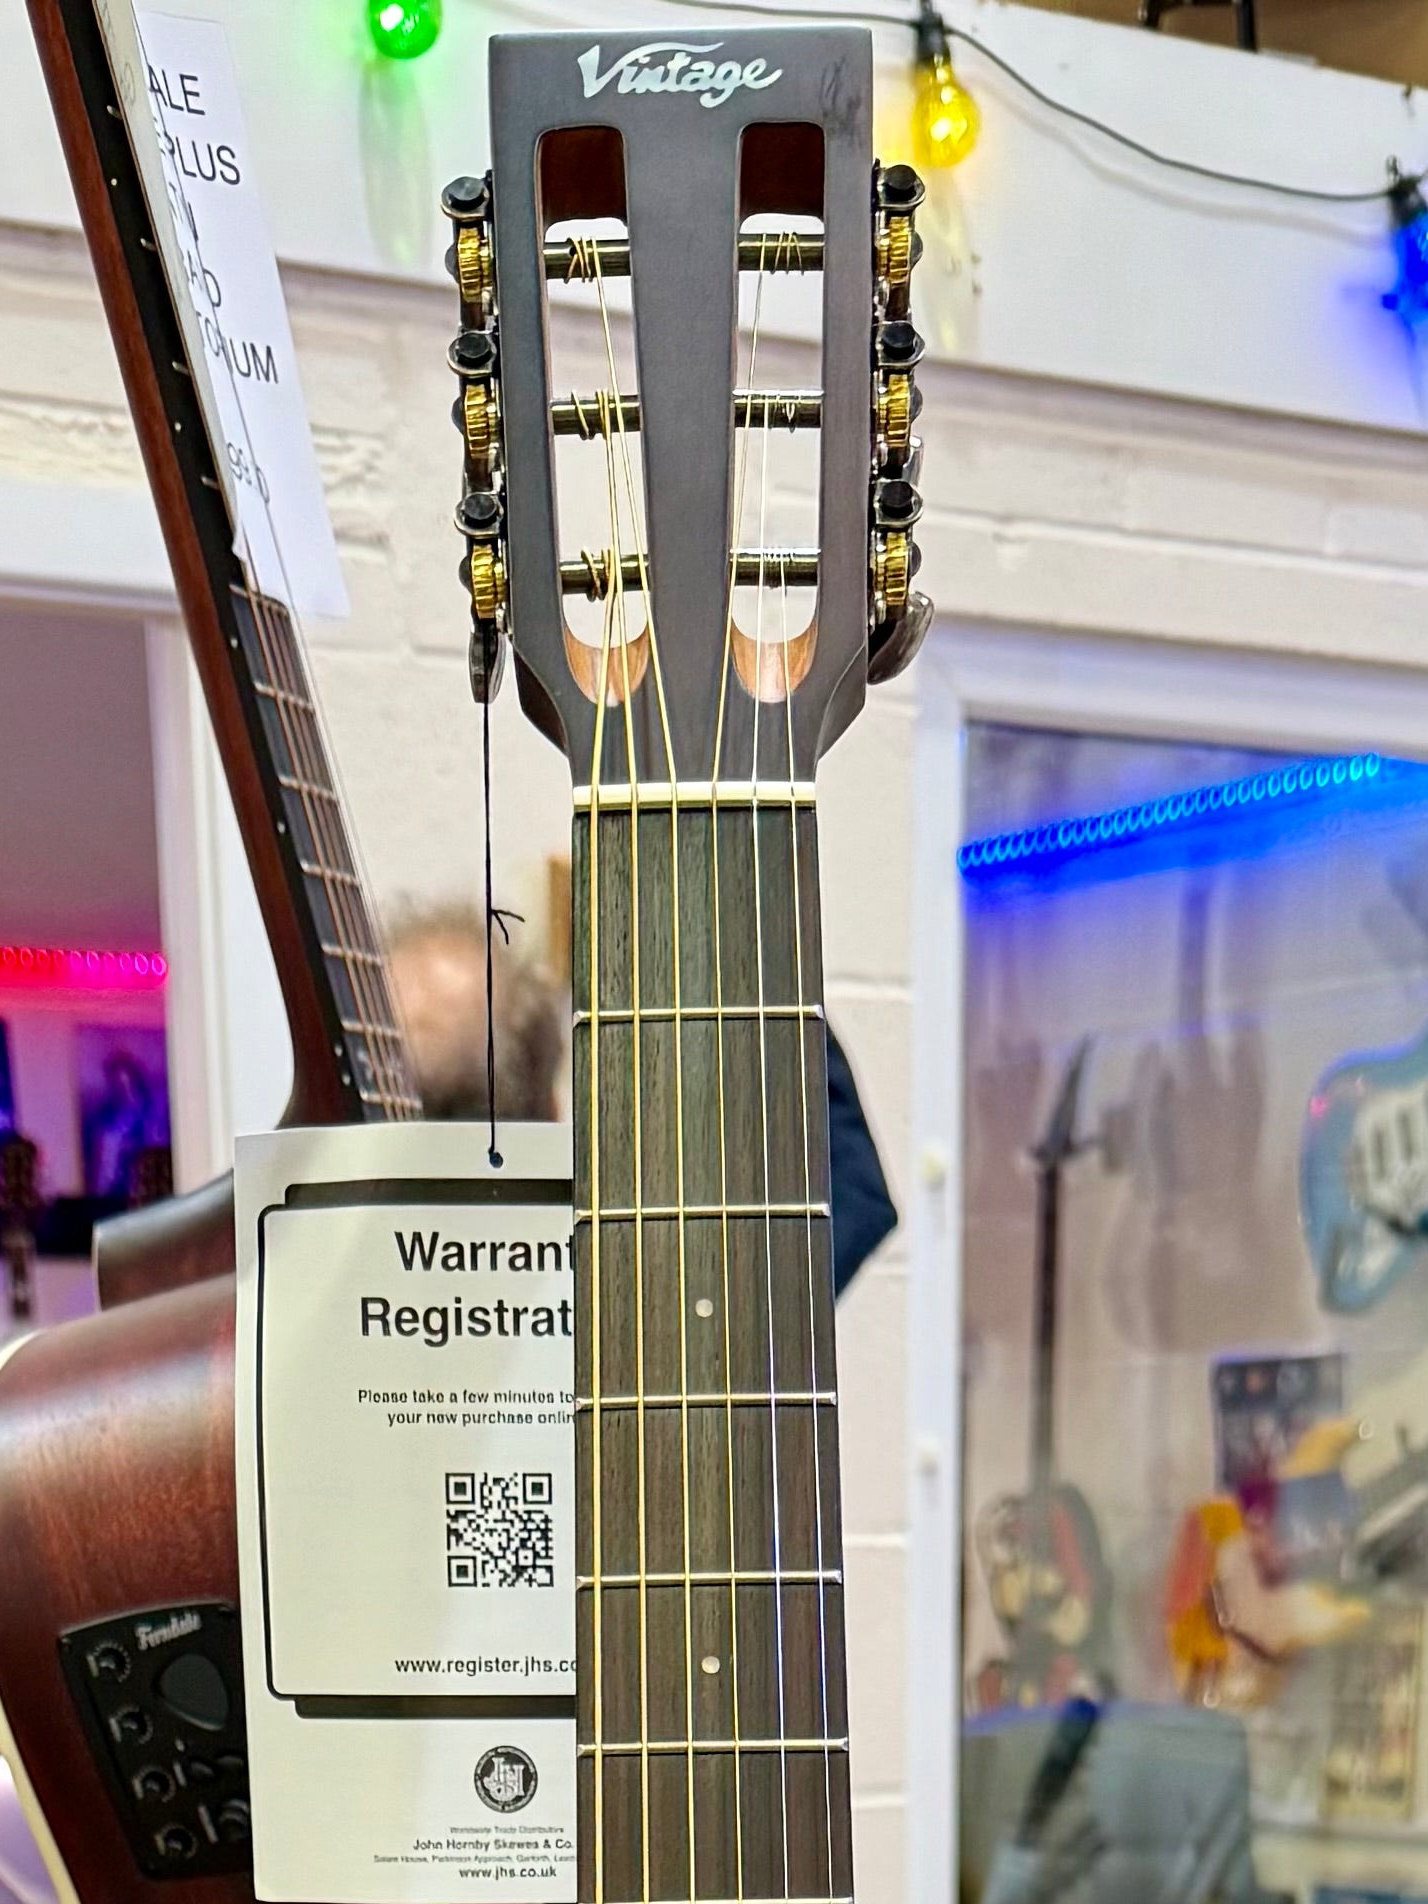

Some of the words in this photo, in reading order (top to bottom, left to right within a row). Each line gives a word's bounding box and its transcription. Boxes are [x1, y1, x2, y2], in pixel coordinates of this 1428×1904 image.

[576, 41, 784, 109] Vintage
[360, 1296, 573, 1348] Registrat
[358, 1388, 408, 1404] Please
[412, 1388, 445, 1404] take
[449, 1391, 458, 1404] a
[463, 1388, 490, 1404] few
[494, 1389, 555, 1404] minutes
[387, 1412, 422, 1428] your
[426, 1412, 458, 1425] new
[462, 1410, 533, 1428] purchase
[412, 1838, 443, 1850] John
[458, 1865, 557, 1881] www.jhs.co.uk
